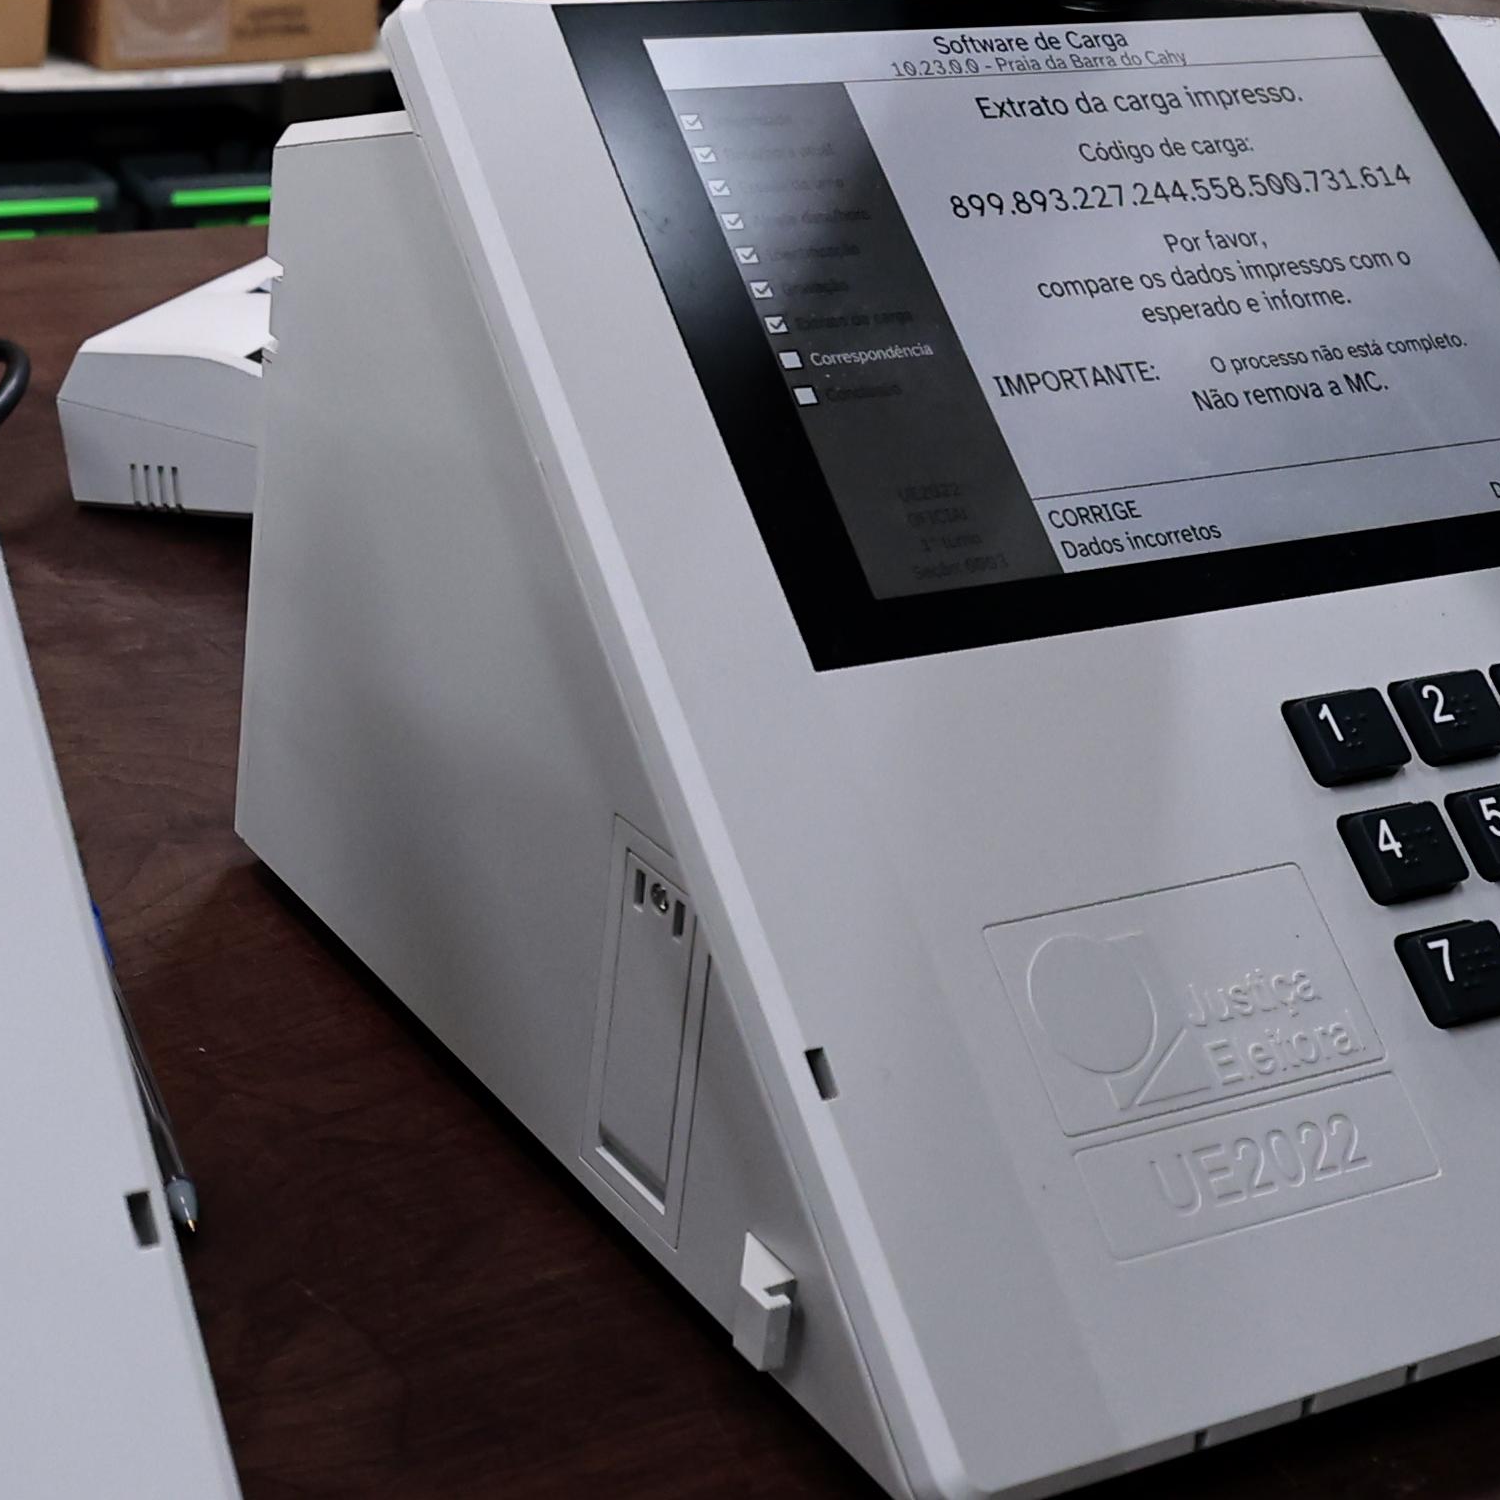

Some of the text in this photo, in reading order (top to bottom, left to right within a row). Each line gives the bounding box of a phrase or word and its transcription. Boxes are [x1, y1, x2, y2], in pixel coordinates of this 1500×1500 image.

[933, 31, 1128, 54] Software de Carga
[892, 48, 1187, 77] 10.23.0.0 Praia da Barra do Cahy
[975, 86, 1303, 119] Extrato da carga impresso.
[1079, 137, 1254, 164] Código de carga:
[950, 164, 1410, 219] 899.893.227.244.558.500.731.614
[1163, 229, 1267, 253] Por favor,
[1038, 251, 1411, 298] compare os dados impressos com o
[1142, 289, 1351, 325] esperado e informe.
[810, 342, 934, 367] Correspondência
[1210, 333, 1467, 375] O processo não está completo.
[993, 361, 1160, 397] IMPORTANTE:
[1192, 371, 1388, 411] Não remova a MC.
[1048, 500, 1142, 529] CORRIGE
[1061, 525, 1221, 559] Dados incorretos
[1319, 704, 1343, 741] 1
[1422, 685, 1455, 723] 2
[1379, 819, 1402, 858] 4
[1427, 939, 1454, 981] 7
[1186, 968, 1321, 1027] Justiça
[1204, 1008, 1366, 1087] Eleitoral
[1150, 1112, 1372, 1217] UE2022
